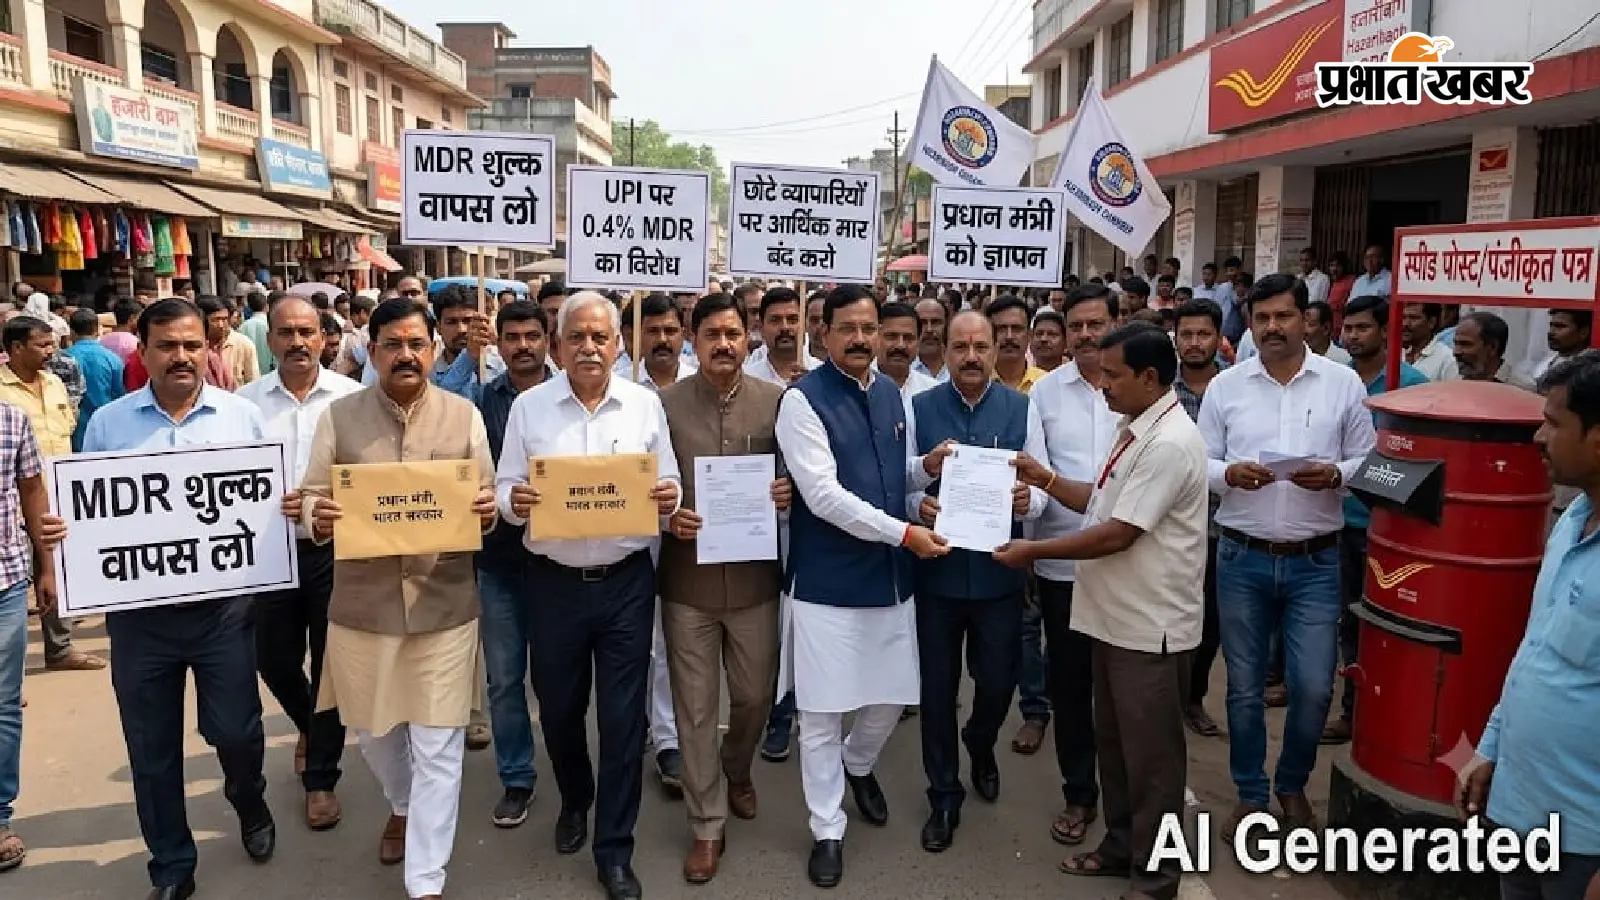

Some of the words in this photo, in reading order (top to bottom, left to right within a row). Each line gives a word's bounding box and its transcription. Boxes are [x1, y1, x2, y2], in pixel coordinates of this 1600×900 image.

[415, 145, 474, 175] MDR
[482, 151, 543, 188] शुल्क
[418, 192, 495, 223] वापस
[502, 185, 540, 225] लो
[605, 179, 642, 204] UPI
[648, 184, 677, 206] पर
[743, 174, 777, 202] छोटे
[781, 178, 868, 207] व्यापारियों
[583, 213, 635, 239] 0.4%
[643, 216, 694, 242] MDR
[739, 213, 764, 233] पर
[768, 207, 831, 236] आर्थिक
[835, 218, 869, 239] मार
[942, 203, 1003, 231] प्रधान
[1009, 198, 1055, 232] मंत्री
[595, 252, 622, 275] का
[627, 245, 681, 276] विरोध
[767, 241, 796, 267] बंद
[800, 242, 837, 270] करो
[945, 234, 978, 267] को
[983, 244, 1048, 271] ज्ञापन
[1405, 240, 1438, 281] स्पीड
[1562, 247, 1594, 283] पत्र
[72, 472, 173, 521] MDR
[184, 467, 274, 526] शुल्क
[99, 537, 200, 583] वापस
[209, 519, 257, 573] लो
